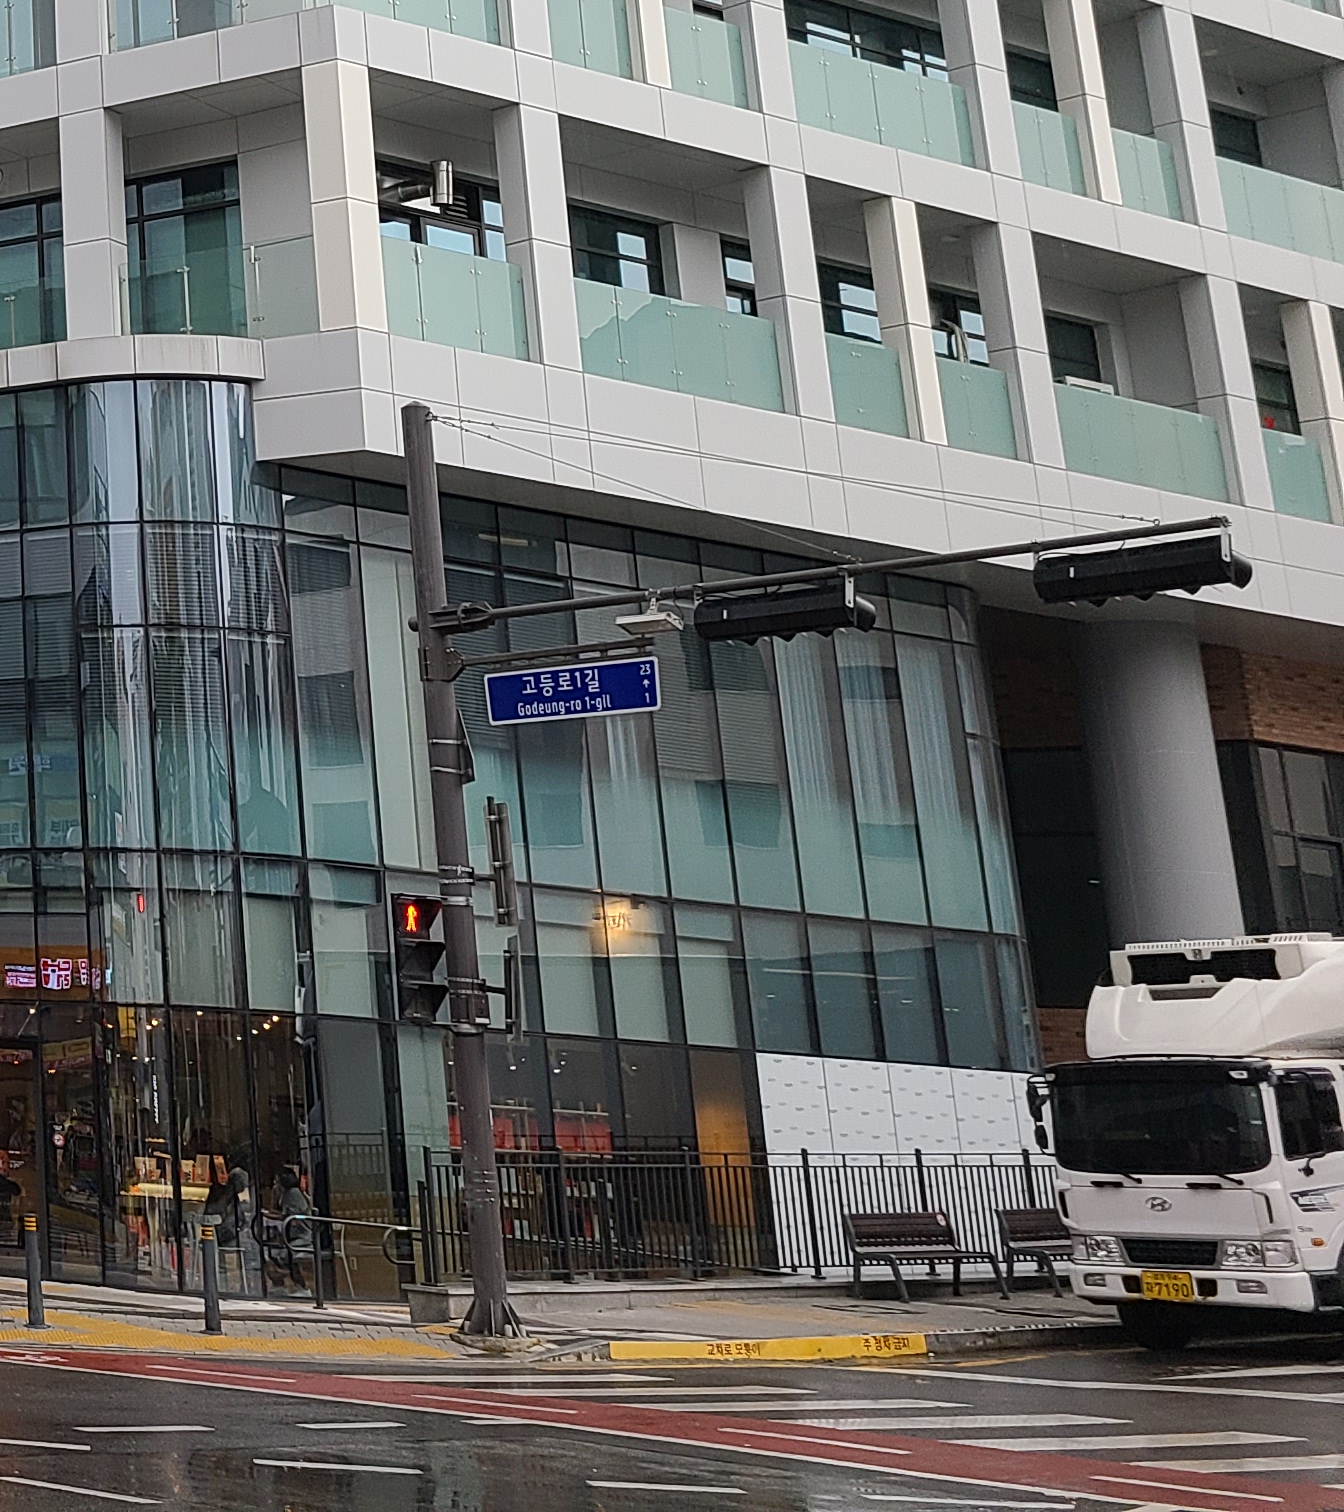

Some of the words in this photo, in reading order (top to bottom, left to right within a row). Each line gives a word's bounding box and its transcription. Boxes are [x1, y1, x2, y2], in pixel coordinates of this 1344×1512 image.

[639, 663, 652, 676] 23
[521, 668, 601, 697] 고등로1길
[517, 699, 582, 717] Godeung-ro
[584, 694, 612, 712] 1-gil
[644, 692, 650, 704] 1
